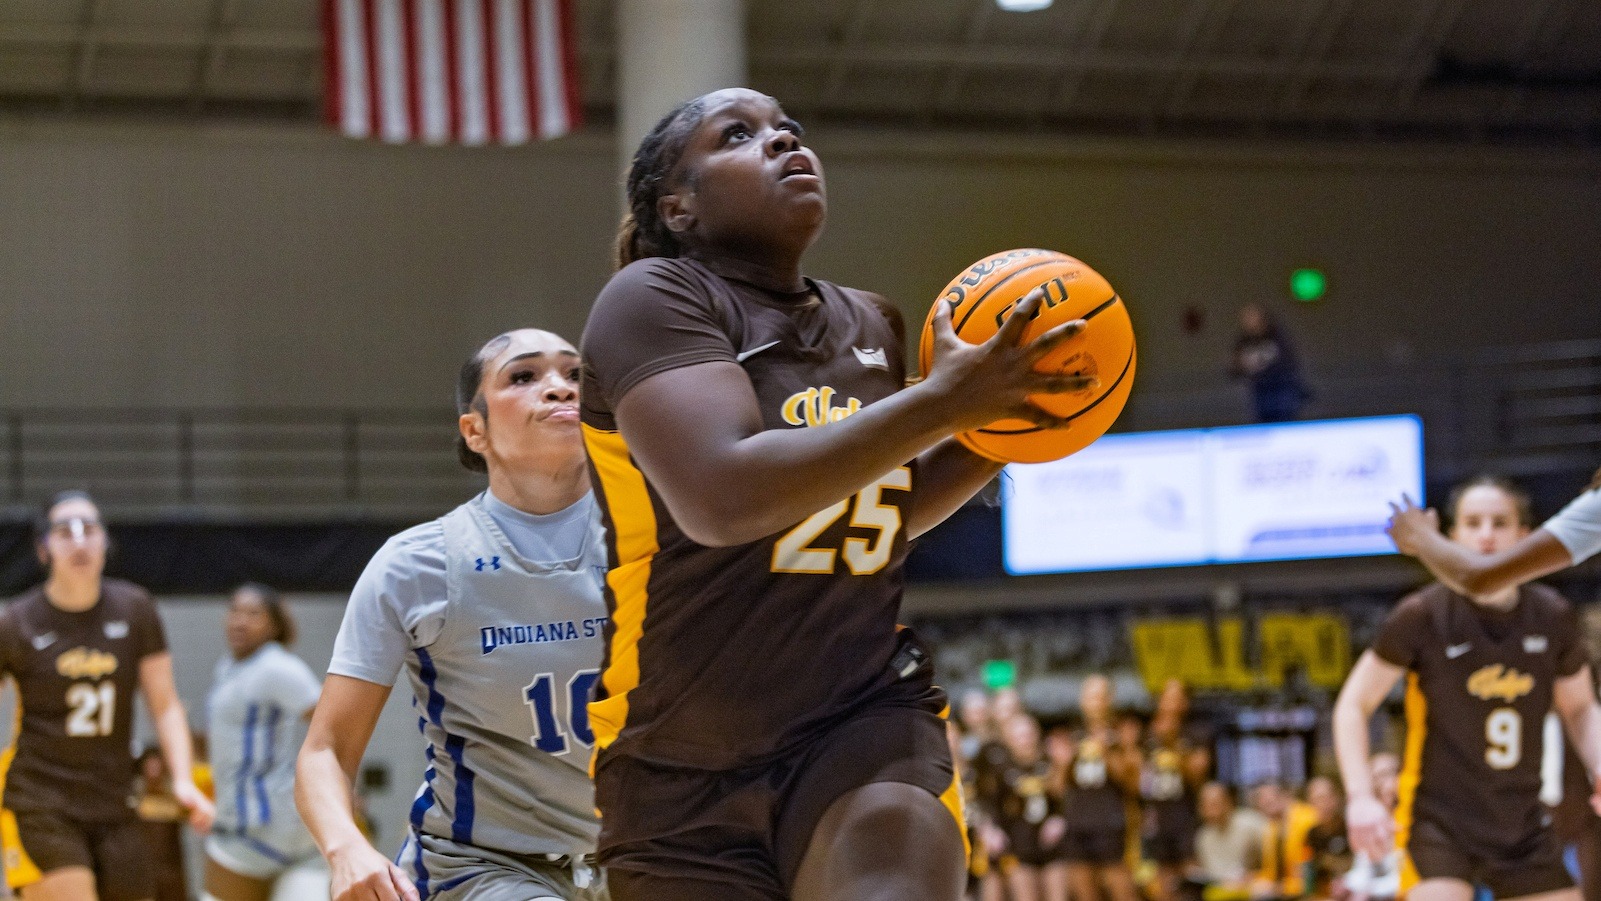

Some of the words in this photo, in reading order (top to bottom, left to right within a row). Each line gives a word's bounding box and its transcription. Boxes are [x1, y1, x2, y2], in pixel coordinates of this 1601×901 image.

[770, 465, 912, 576] 25
[65, 682, 116, 737] 21
[1485, 707, 1522, 770] 9
